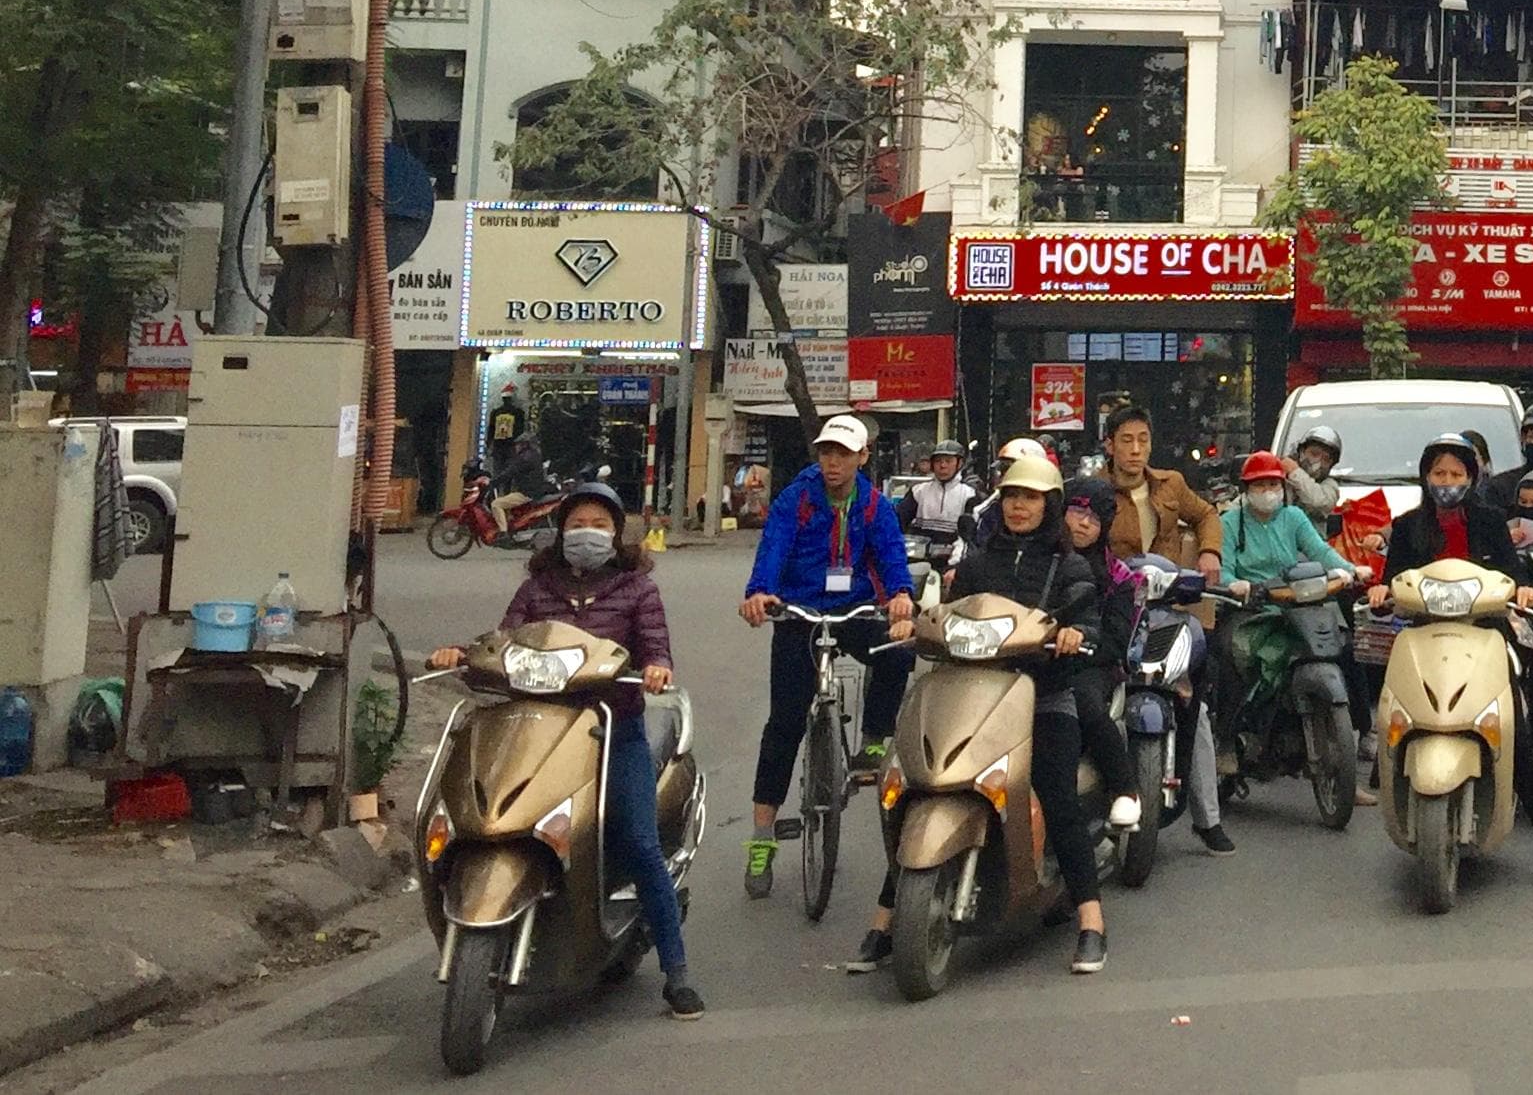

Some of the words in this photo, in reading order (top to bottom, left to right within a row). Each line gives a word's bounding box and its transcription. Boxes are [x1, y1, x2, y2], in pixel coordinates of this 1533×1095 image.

[1436, 224, 1456, 238] VỤ
[1482, 224, 1526, 238] THUẬT
[973, 248, 1008, 264] HOUSE
[1039, 242, 1149, 275] HOUSE
[1161, 242, 1193, 267] OF
[1202, 242, 1268, 275] CHA
[1463, 244, 1507, 263] XE
[398, 270, 423, 289] BÁN
[817, 271, 845, 282] NGA
[1483, 289, 1522, 299] YAMAHA
[505, 300, 664, 322] ROBERTO
[1044, 381, 1074, 394] 32K
